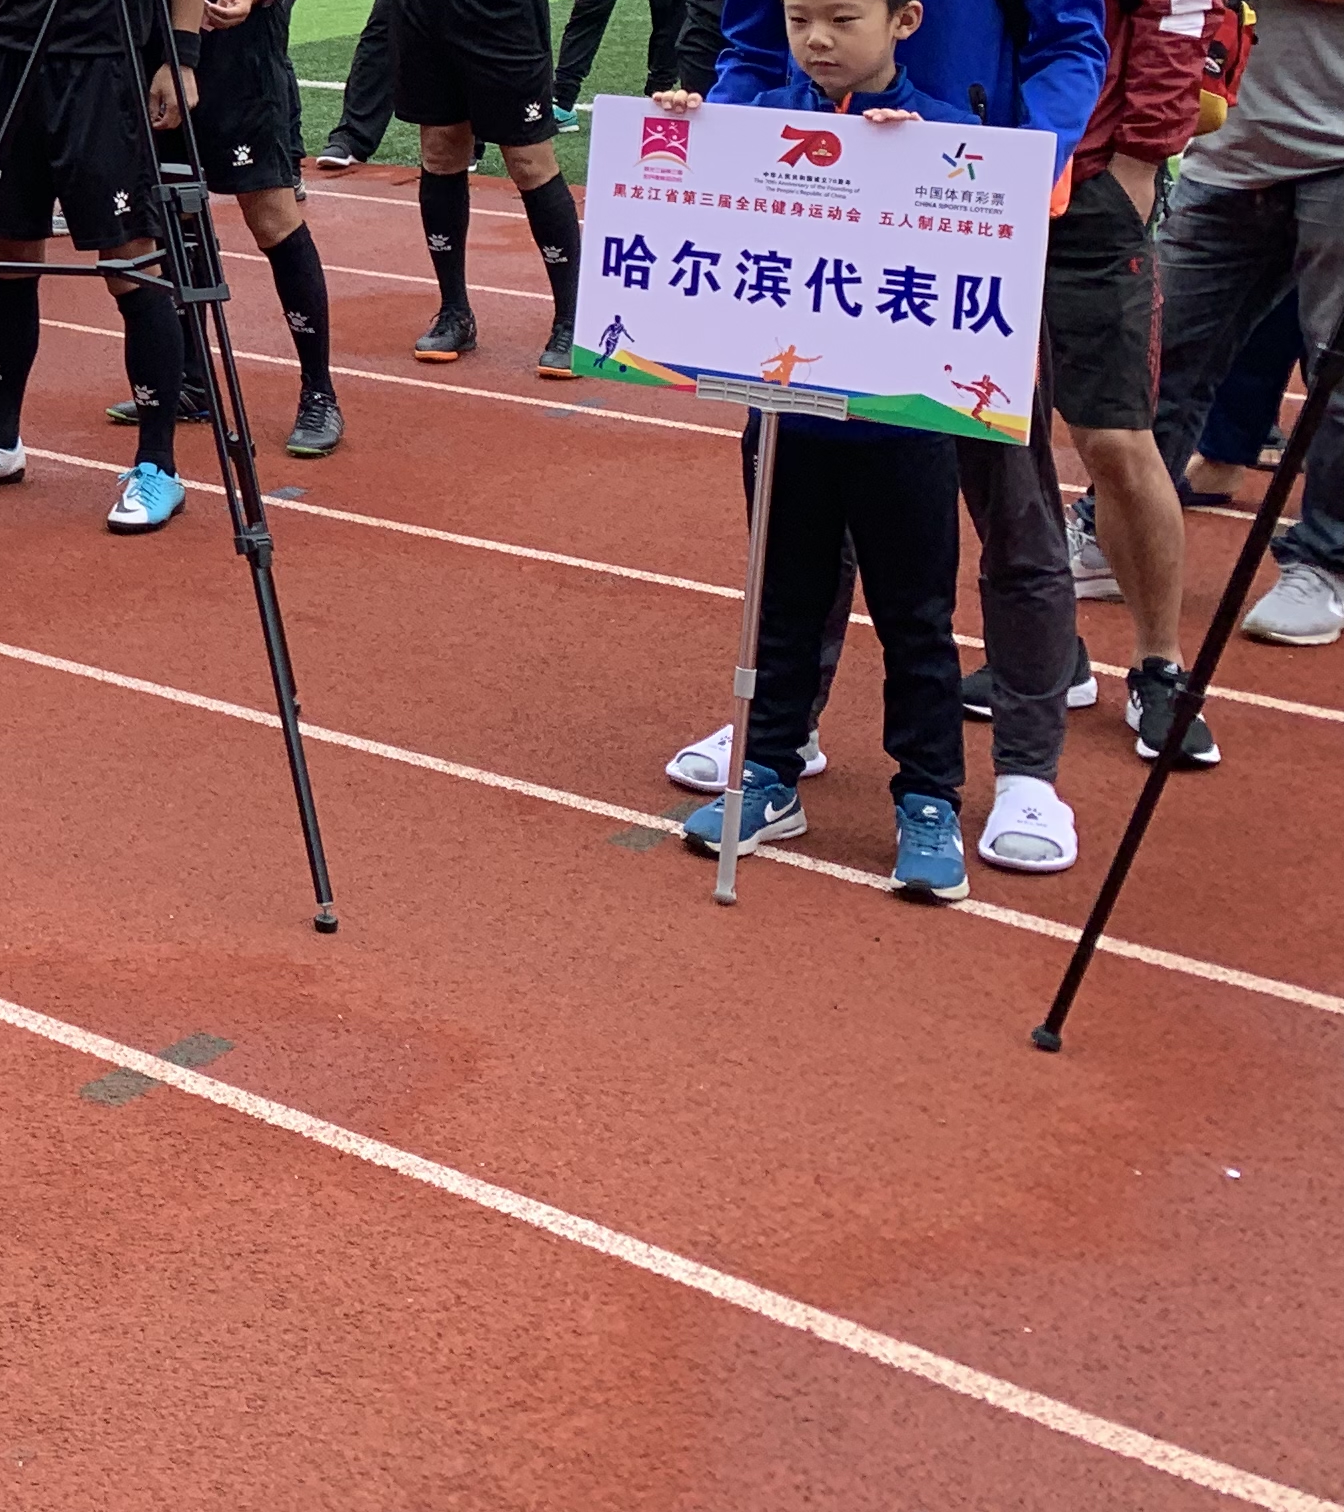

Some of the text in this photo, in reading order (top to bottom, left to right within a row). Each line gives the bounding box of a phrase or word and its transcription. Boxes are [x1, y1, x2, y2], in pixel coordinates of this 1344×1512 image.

[776, 124, 842, 168] 70
[613, 182, 1015, 240] 黑龙江省第三届全民健身运动会 五人制足球比赛
[915, 186, 1005, 206] 中国体育彩票
[602, 234, 1014, 338] 哈尔滨代表队
